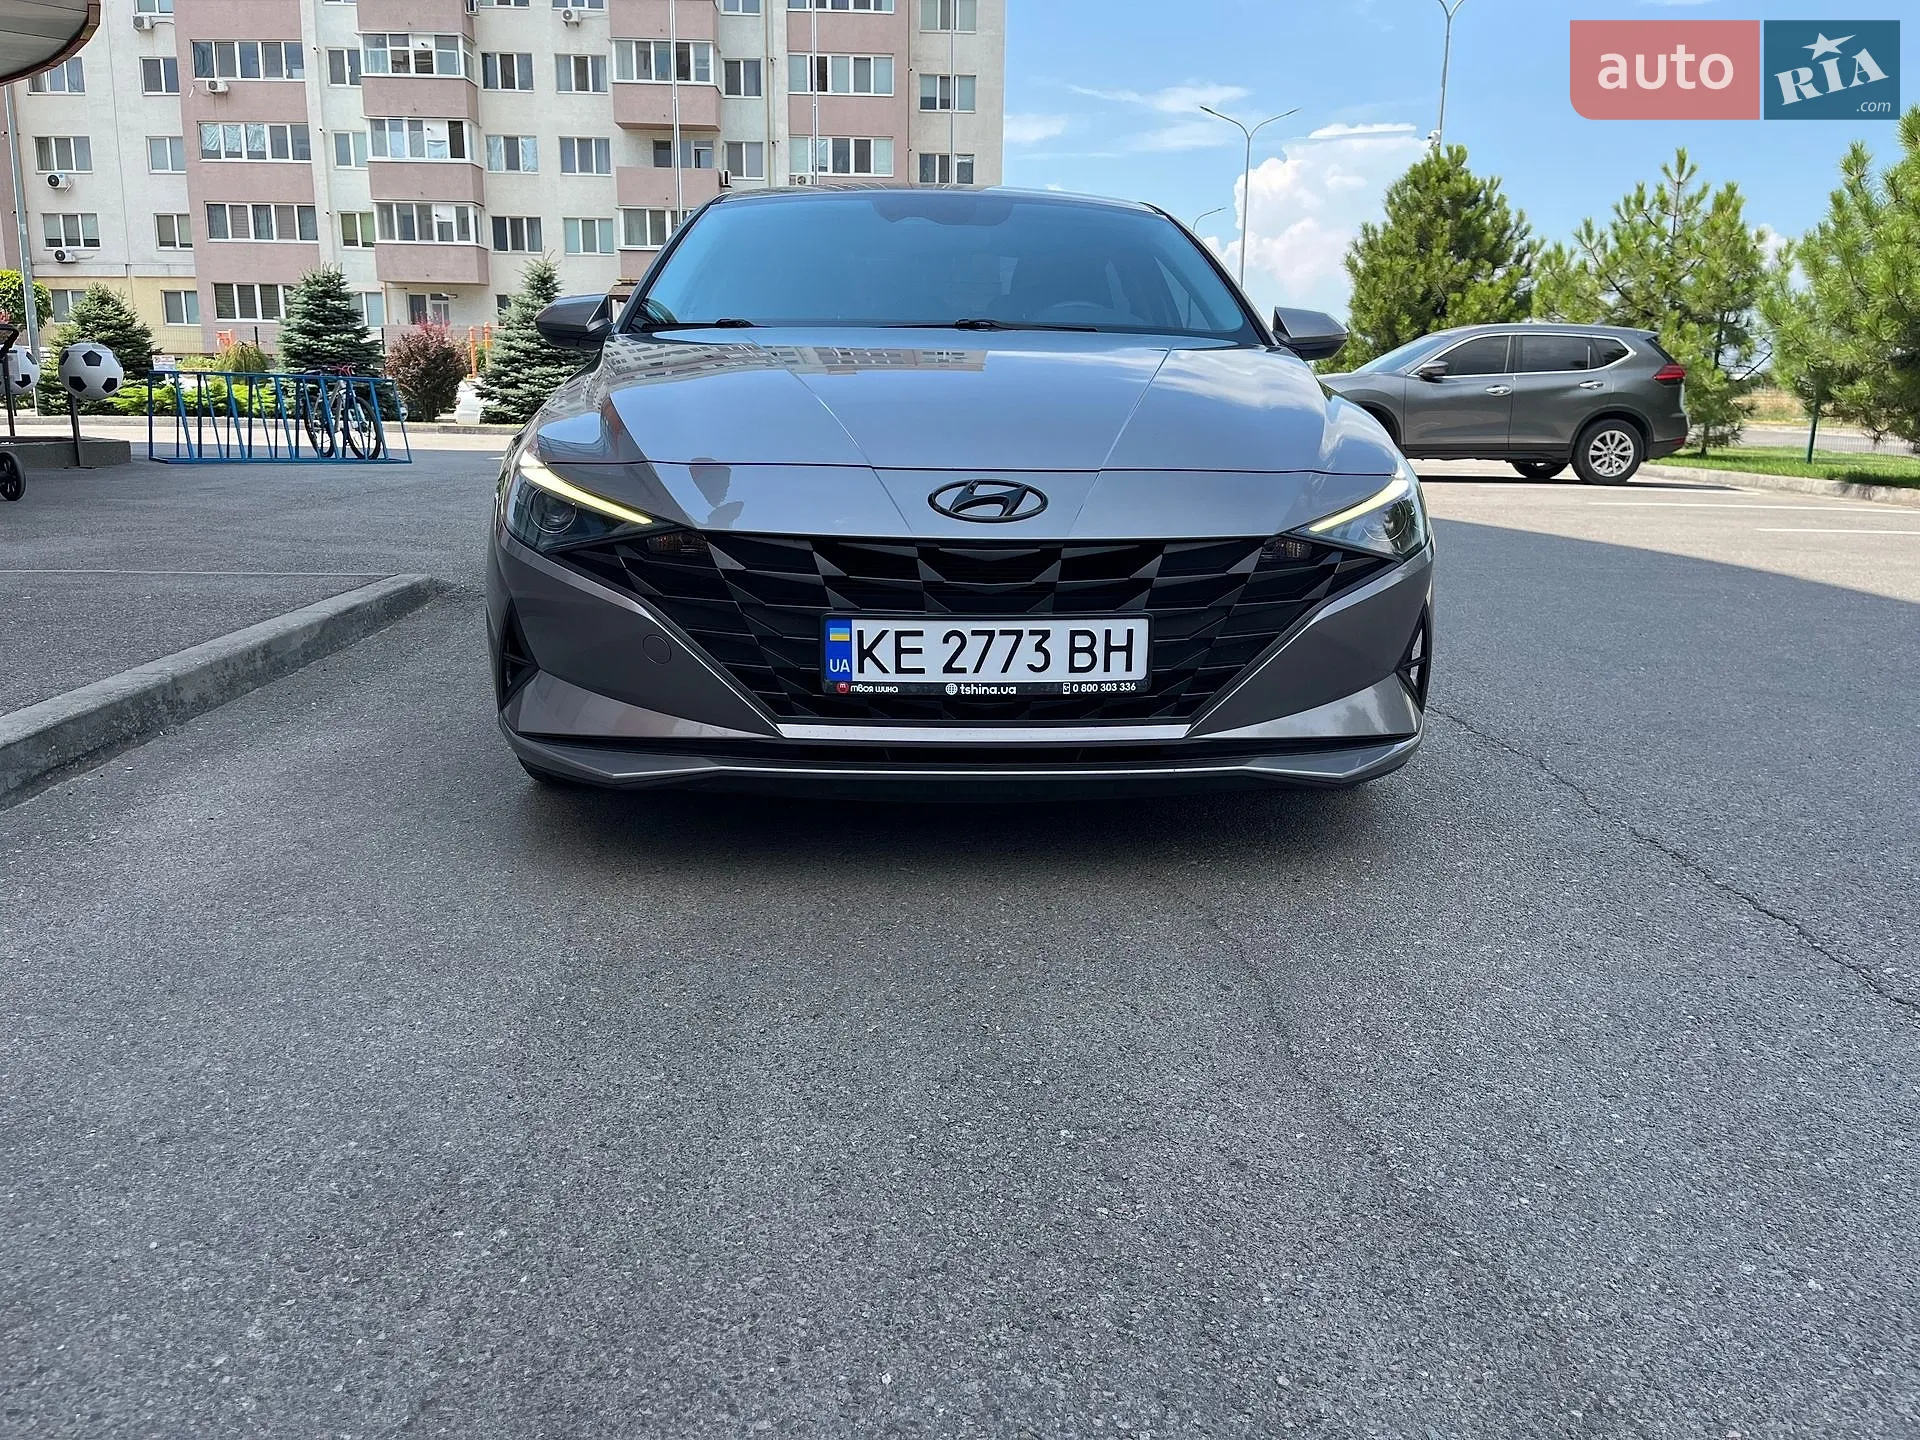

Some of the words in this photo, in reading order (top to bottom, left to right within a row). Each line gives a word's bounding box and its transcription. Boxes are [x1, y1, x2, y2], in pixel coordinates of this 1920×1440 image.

[856, 629, 926, 674] KE
[942, 629, 1051, 674] 2773
[1068, 628, 1134, 674] BH
[829, 658, 851, 673] UA
[960, 683, 1017, 695] tshina.ua
[1072, 683, 1079, 693] 0
[1080, 683, 1098, 693] 800
[1100, 682, 1117, 692] 303
[1119, 682, 1136, 692] 336
